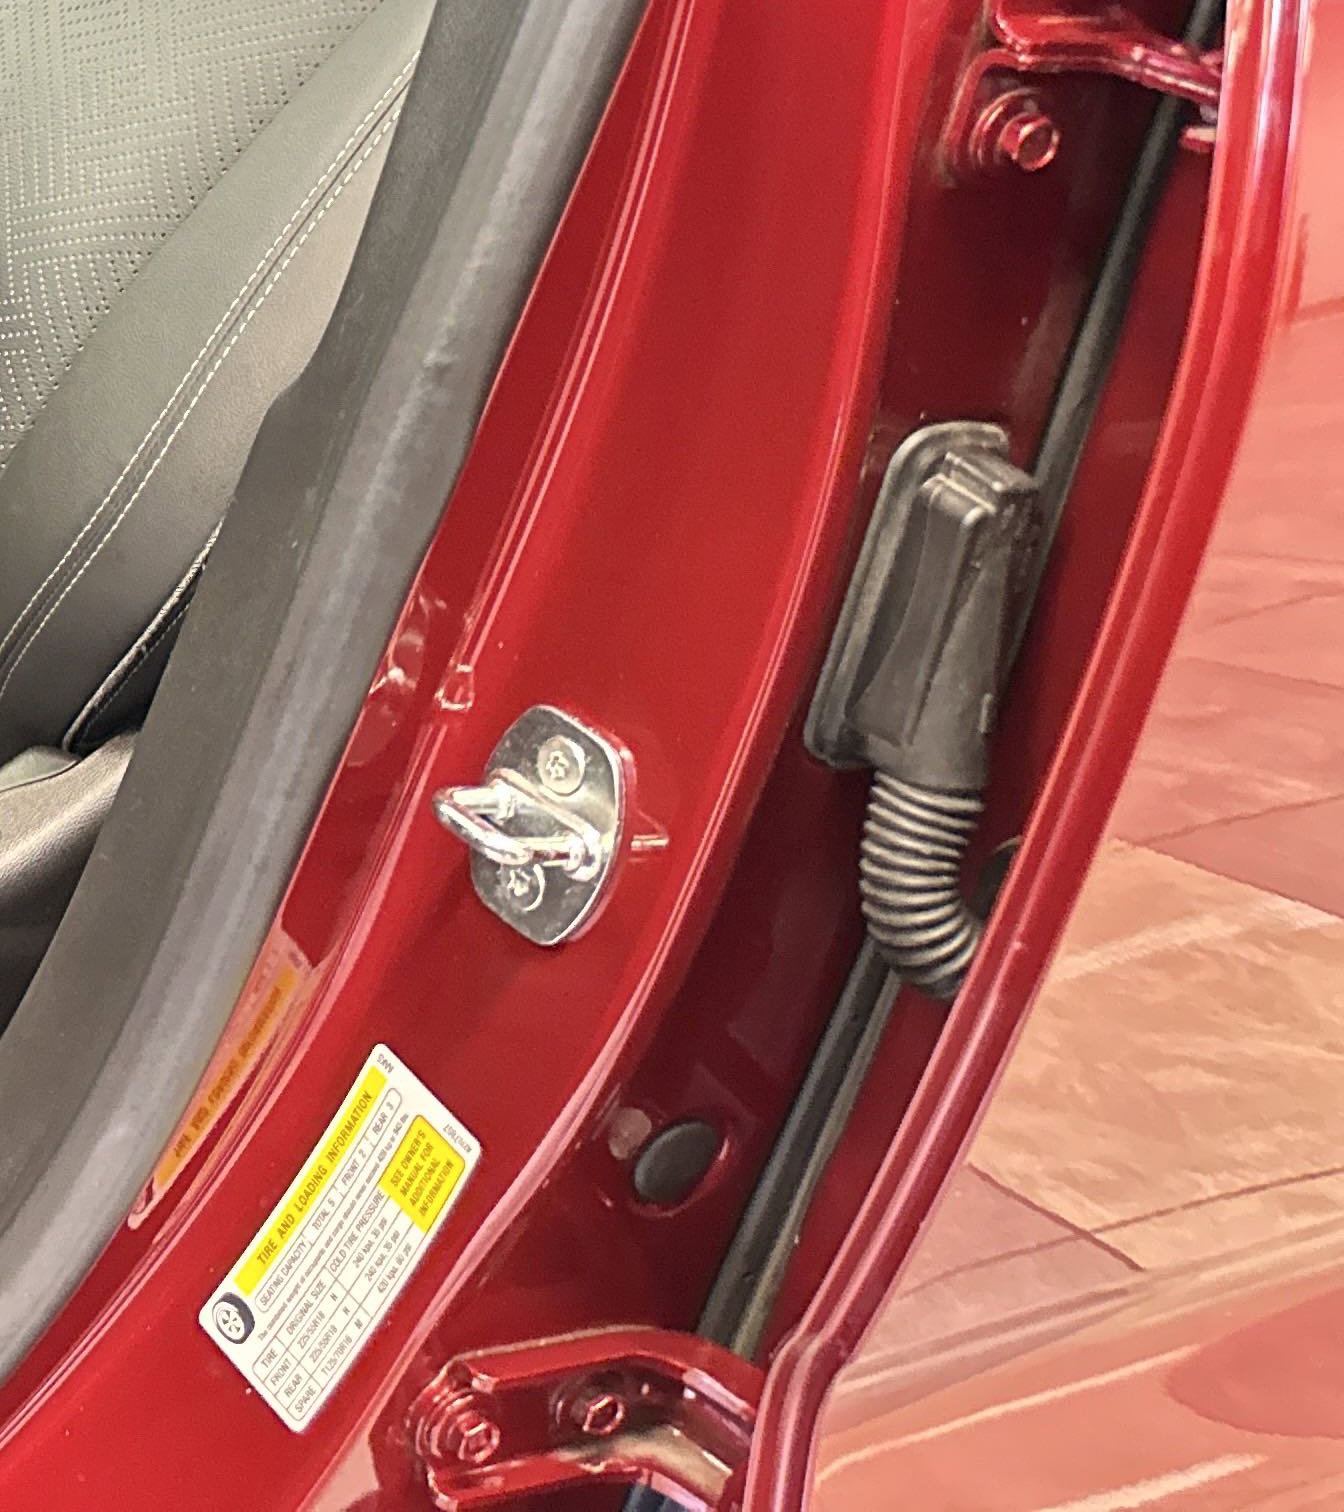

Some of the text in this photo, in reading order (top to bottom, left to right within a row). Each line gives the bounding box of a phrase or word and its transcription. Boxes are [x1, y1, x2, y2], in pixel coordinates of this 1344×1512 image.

[372, 1101, 393, 1134] REAR 3
[257, 1090, 371, 1265] TIRE AND LOADING INFORMATION
[341, 1148, 366, 1185] FRONT 2
[390, 1168, 403, 1187] SEE
[401, 1129, 425, 1169] OWNER'S
[399, 1142, 433, 1196] MANUAL FOR
[409, 1156, 440, 1205] ADDITIONAL
[418, 1159, 453, 1216] INFORMATION
[312, 1207, 329, 1230] TOTAL
[329, 1190, 384, 1272] COLD TIRE PRESSURE
[260, 1240, 306, 1306] SEATING CAPACITY
[286, 1279, 325, 1335] ORIGINAL SIZE
[261, 1348, 277, 1368] TIRE
[271, 1358, 291, 1385] FRONT
[285, 1373, 302, 1397] REAR
[295, 1385, 315, 1413] SPARE
